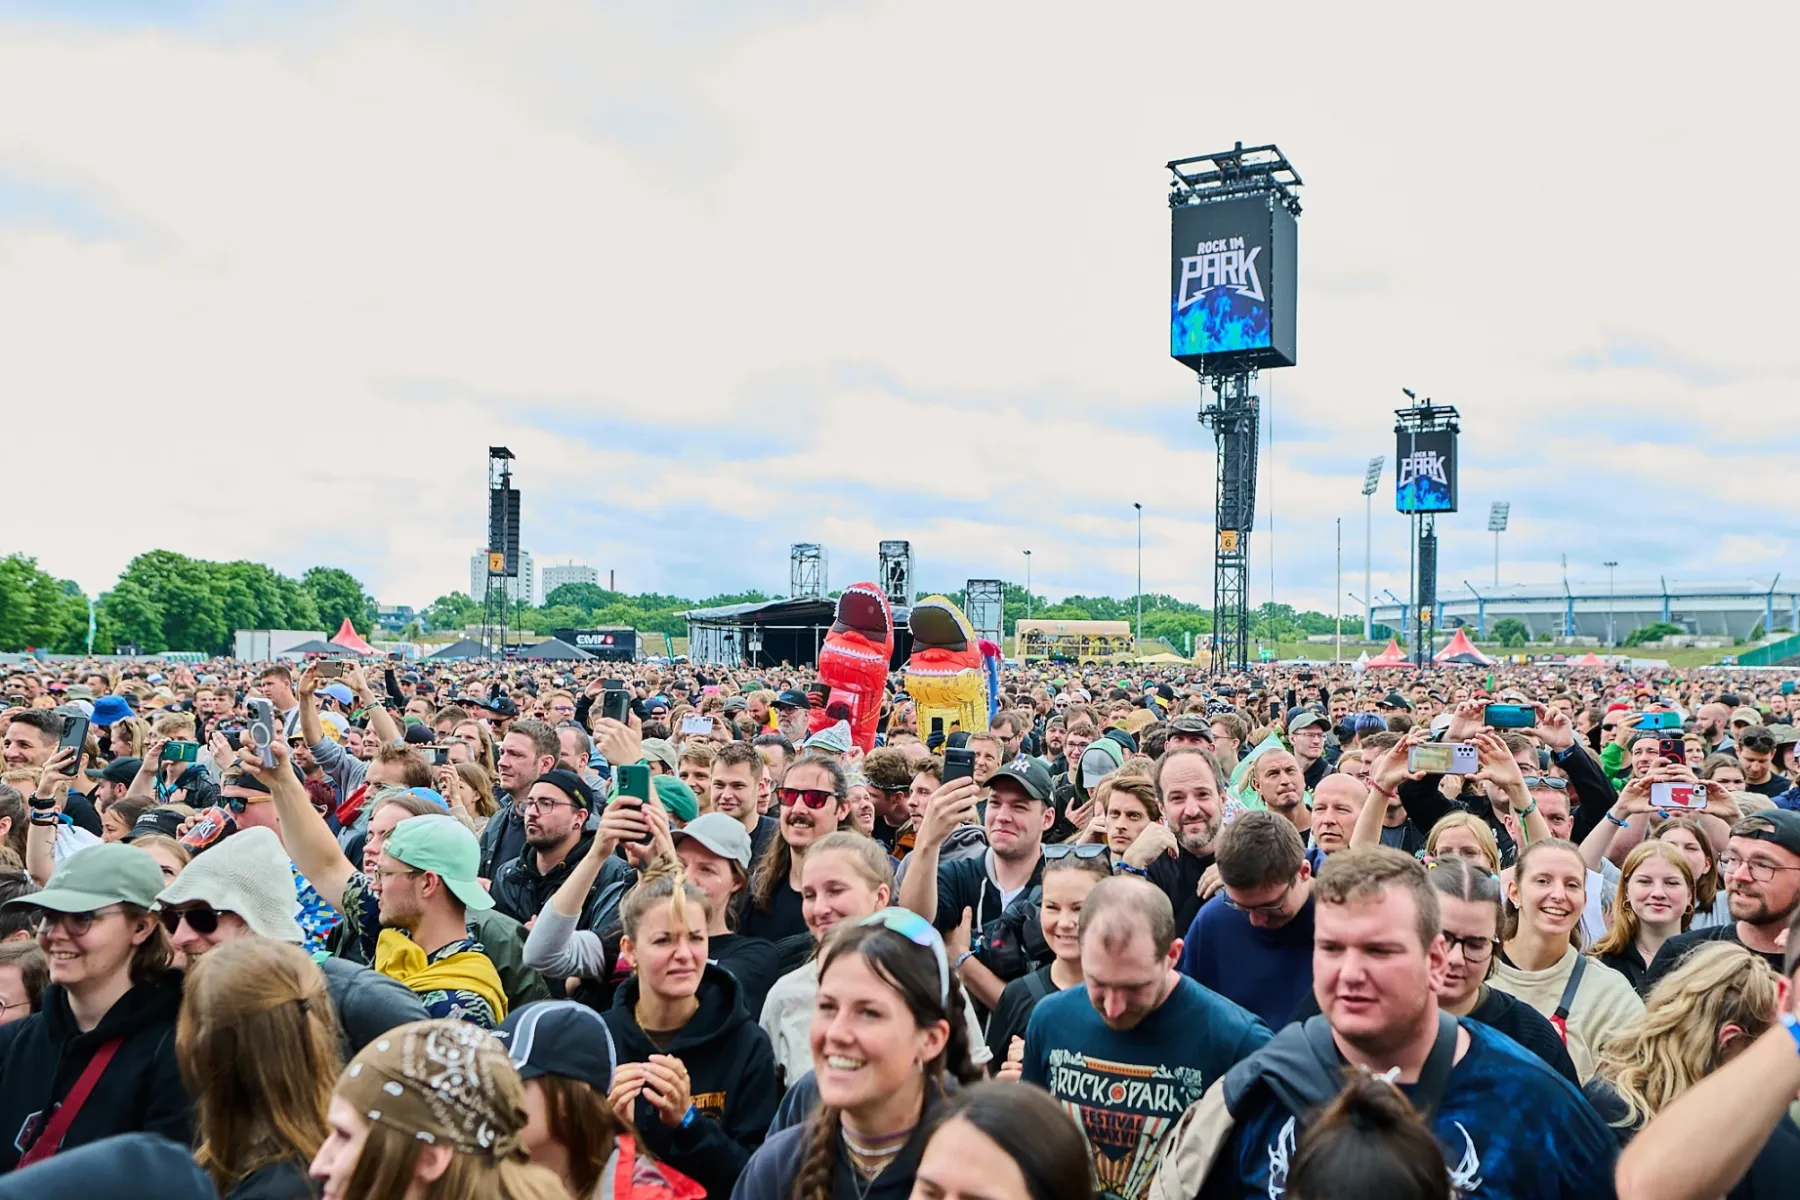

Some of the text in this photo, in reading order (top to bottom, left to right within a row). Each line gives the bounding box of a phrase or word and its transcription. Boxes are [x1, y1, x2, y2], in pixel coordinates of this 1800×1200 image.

[1197, 236, 1245, 255] ROCK IM
[1178, 246, 1265, 311] PARK
[1400, 456, 1448, 488] PARK
[1225, 539, 1231, 547] 6
[493, 560, 499, 568] 7
[576, 634, 605, 644] EMP
[1057, 1066, 1184, 1113] ROCK PARK
[1081, 1107, 1145, 1131] FESTIVAL
